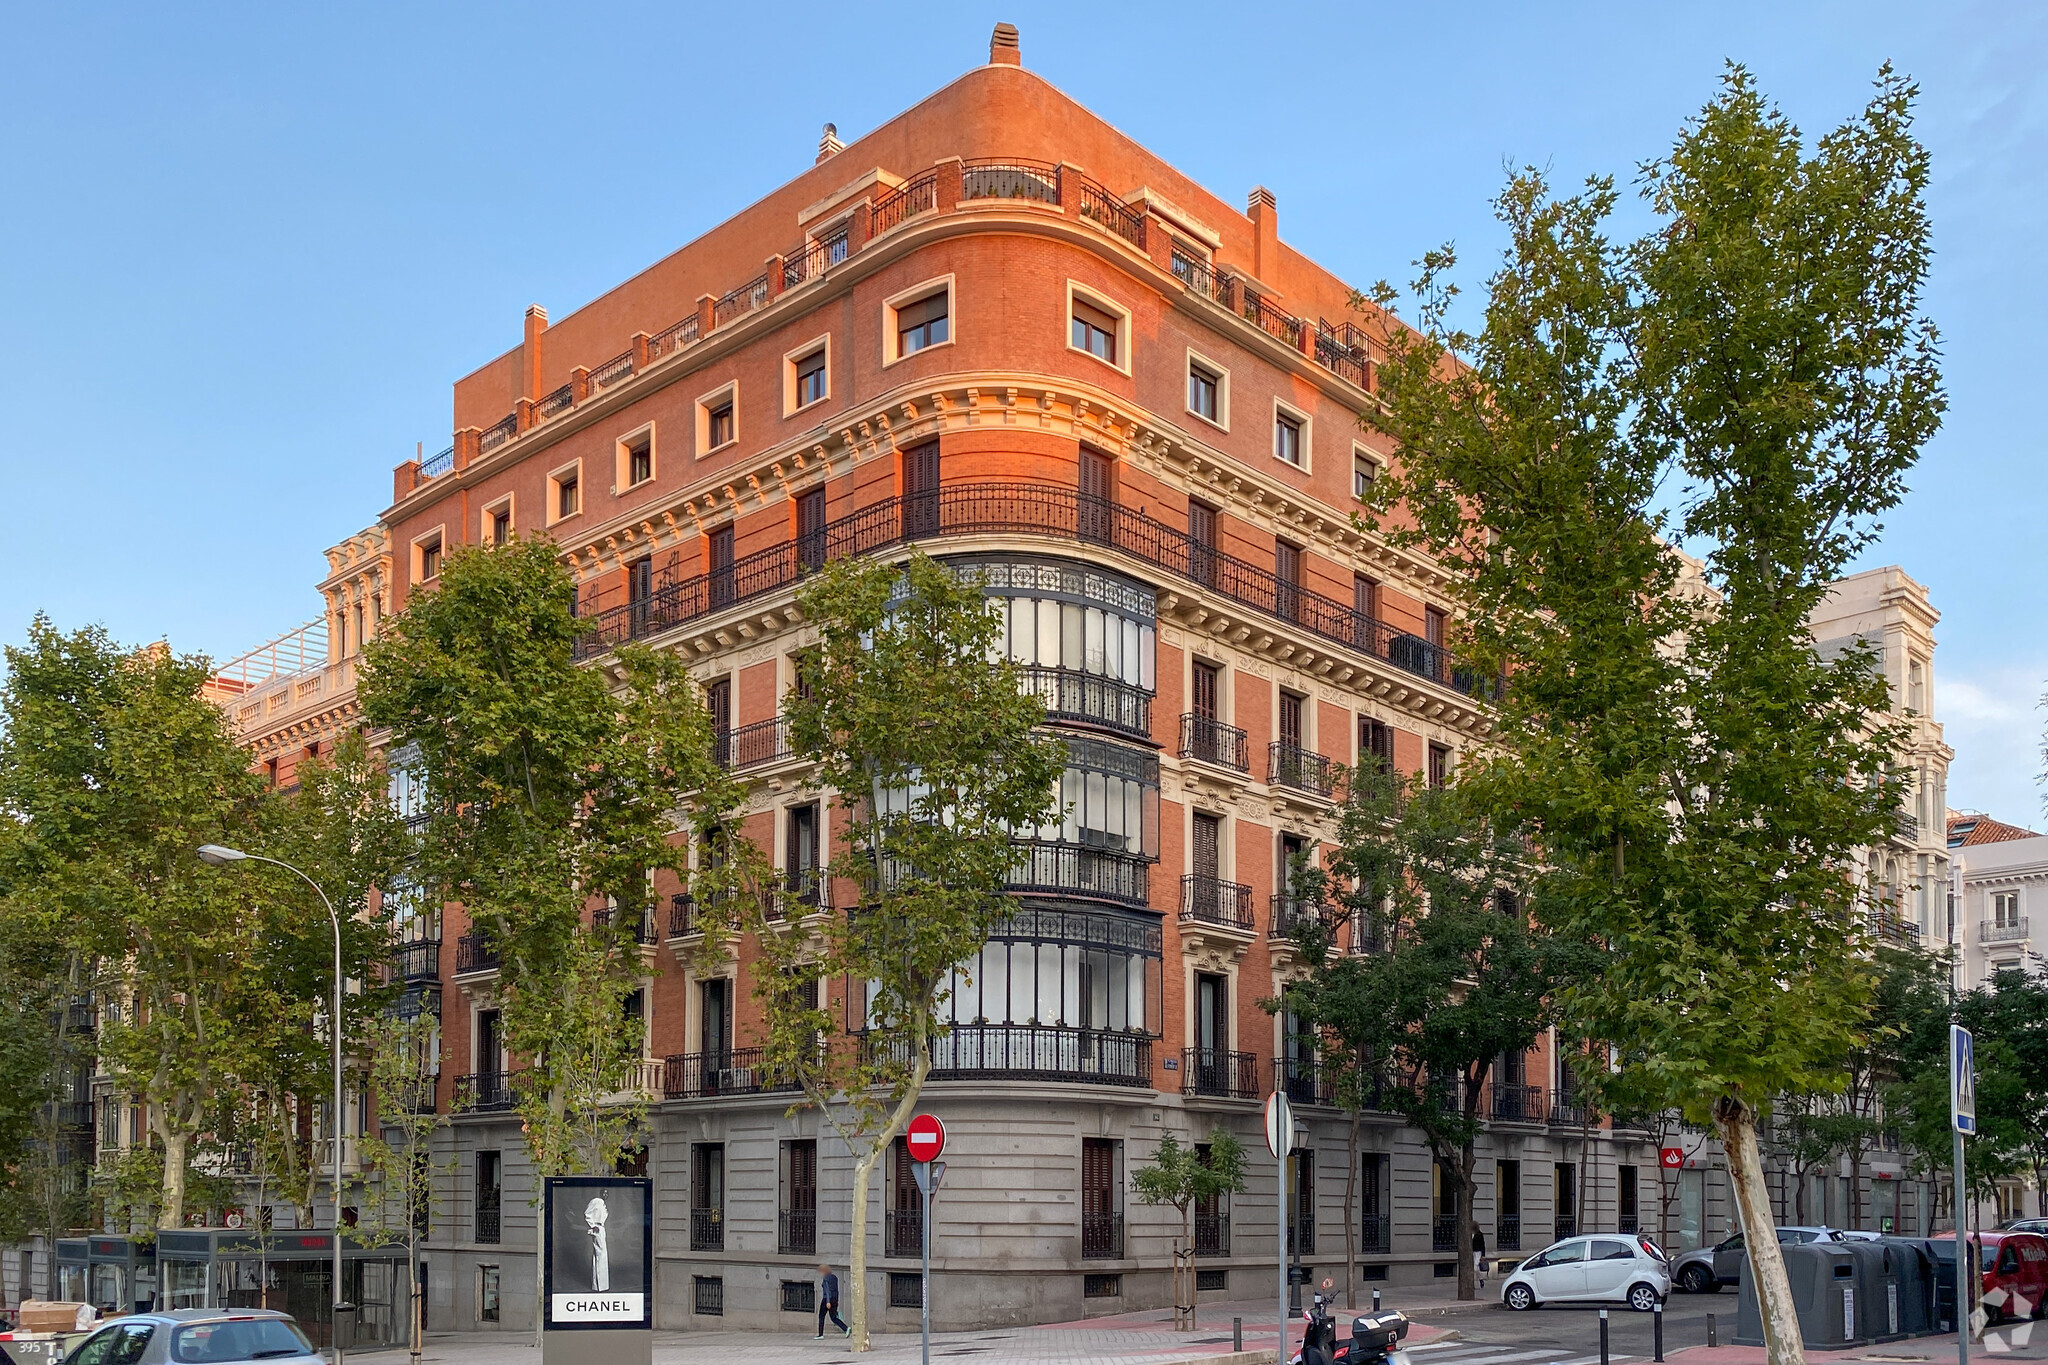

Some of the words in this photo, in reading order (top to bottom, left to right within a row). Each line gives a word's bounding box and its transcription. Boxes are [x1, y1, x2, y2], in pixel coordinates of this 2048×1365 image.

[2021, 1247, 2047, 1262] Miele
[565, 1301, 631, 1312] CHANEL
[19, 1341, 41, 1353] 395
